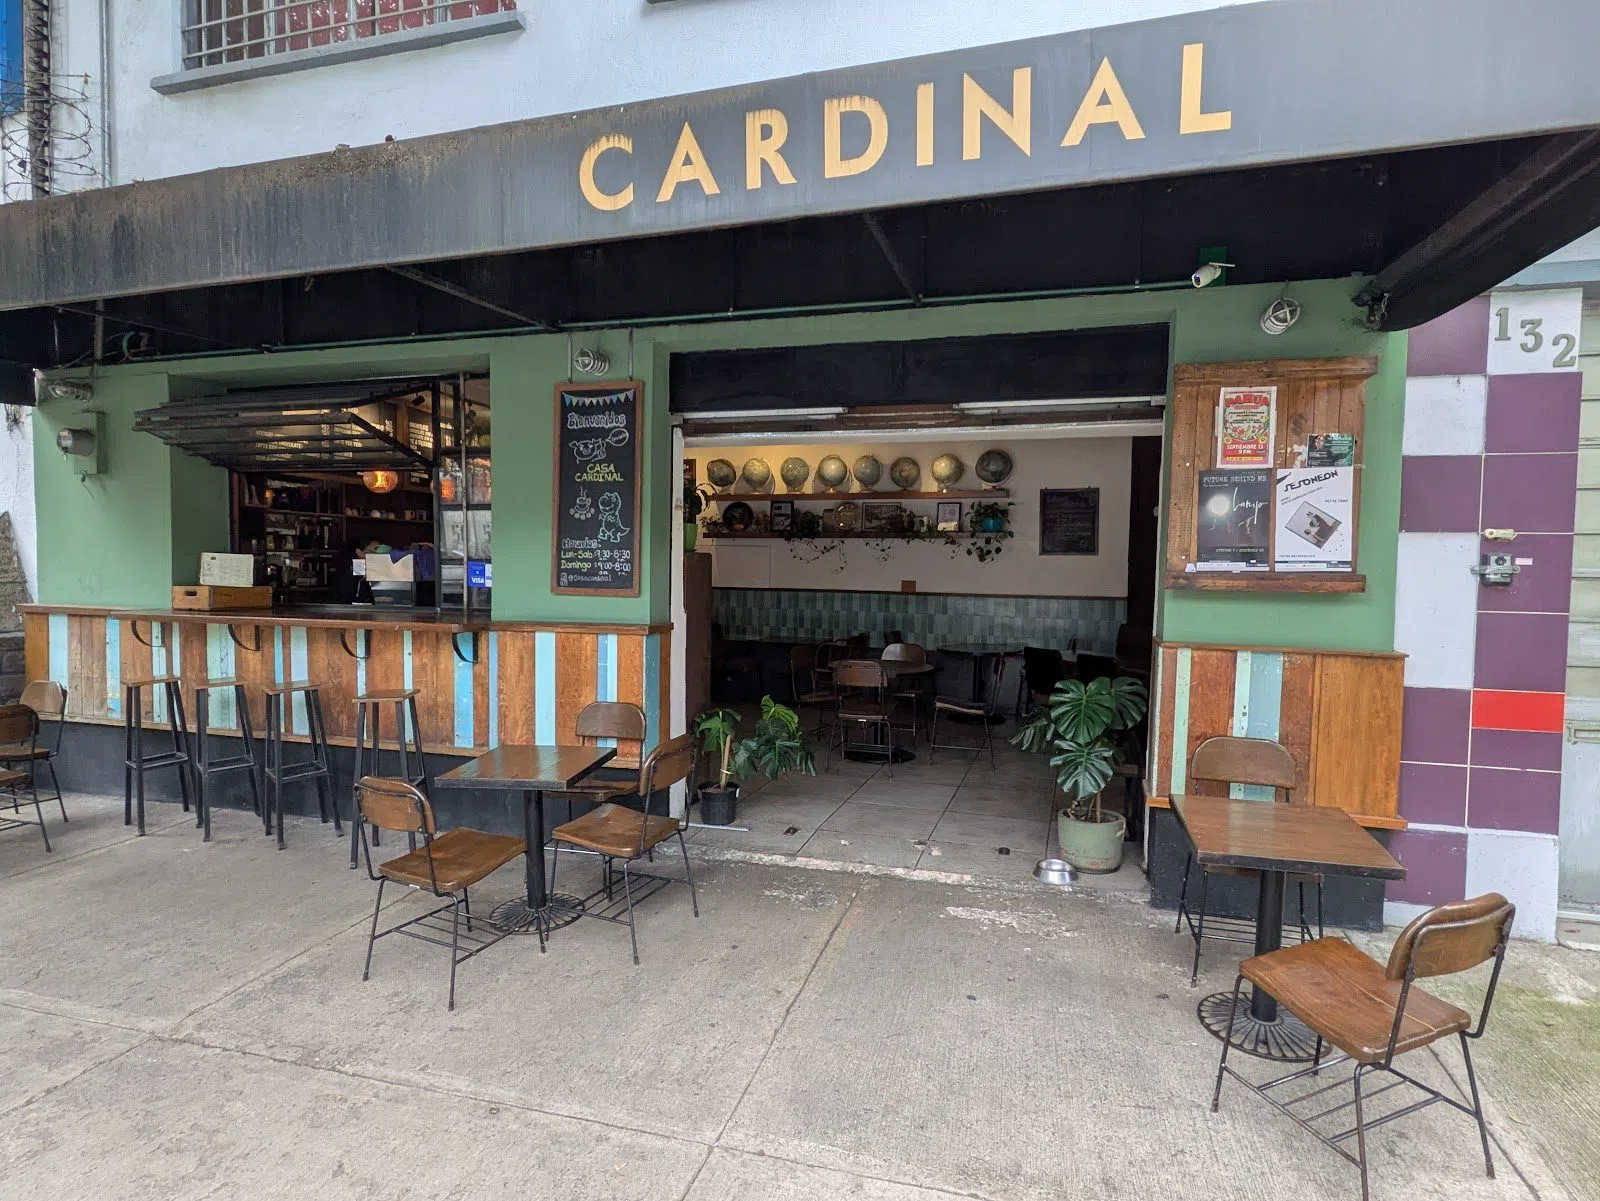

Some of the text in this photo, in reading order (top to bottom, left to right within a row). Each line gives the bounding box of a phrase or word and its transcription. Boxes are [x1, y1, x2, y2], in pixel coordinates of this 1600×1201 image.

[579, 43, 1232, 211] CARDINAL
[1494, 307, 1577, 368] 132
[567, 411, 627, 429] Bienvenidos
[586, 463, 615, 473] CASA
[574, 472, 624, 482] CARDINAL
[560, 560, 592, 572] Domingo
